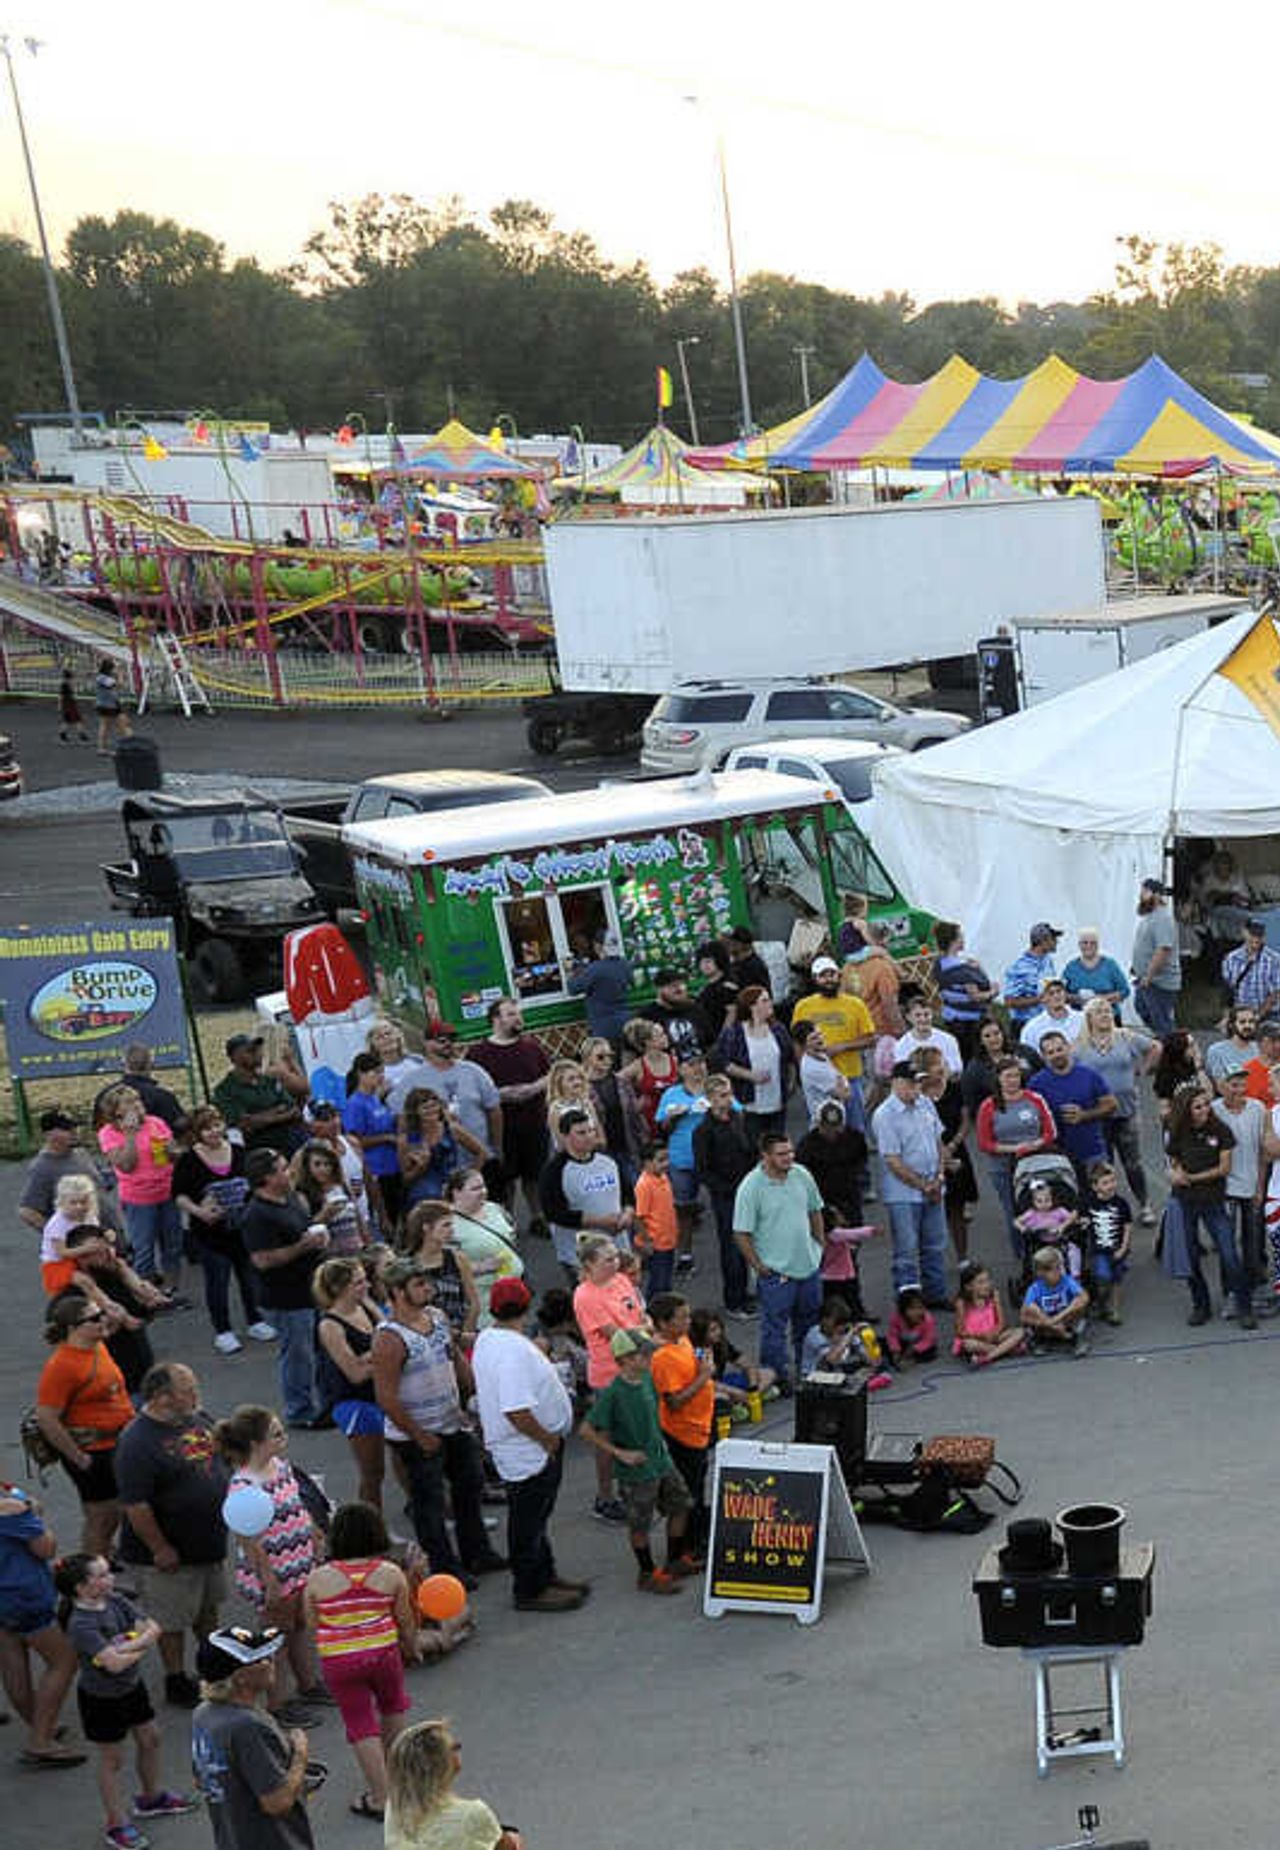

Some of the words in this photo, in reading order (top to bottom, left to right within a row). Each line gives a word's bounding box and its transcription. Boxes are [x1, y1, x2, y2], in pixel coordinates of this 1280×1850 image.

[72, 968, 143, 986] Bump
[88, 984, 154, 1000] Drive
[724, 1489, 778, 1519] WADE
[752, 1520, 814, 1551] HENRY
[725, 1549, 806, 1567] SHOW
